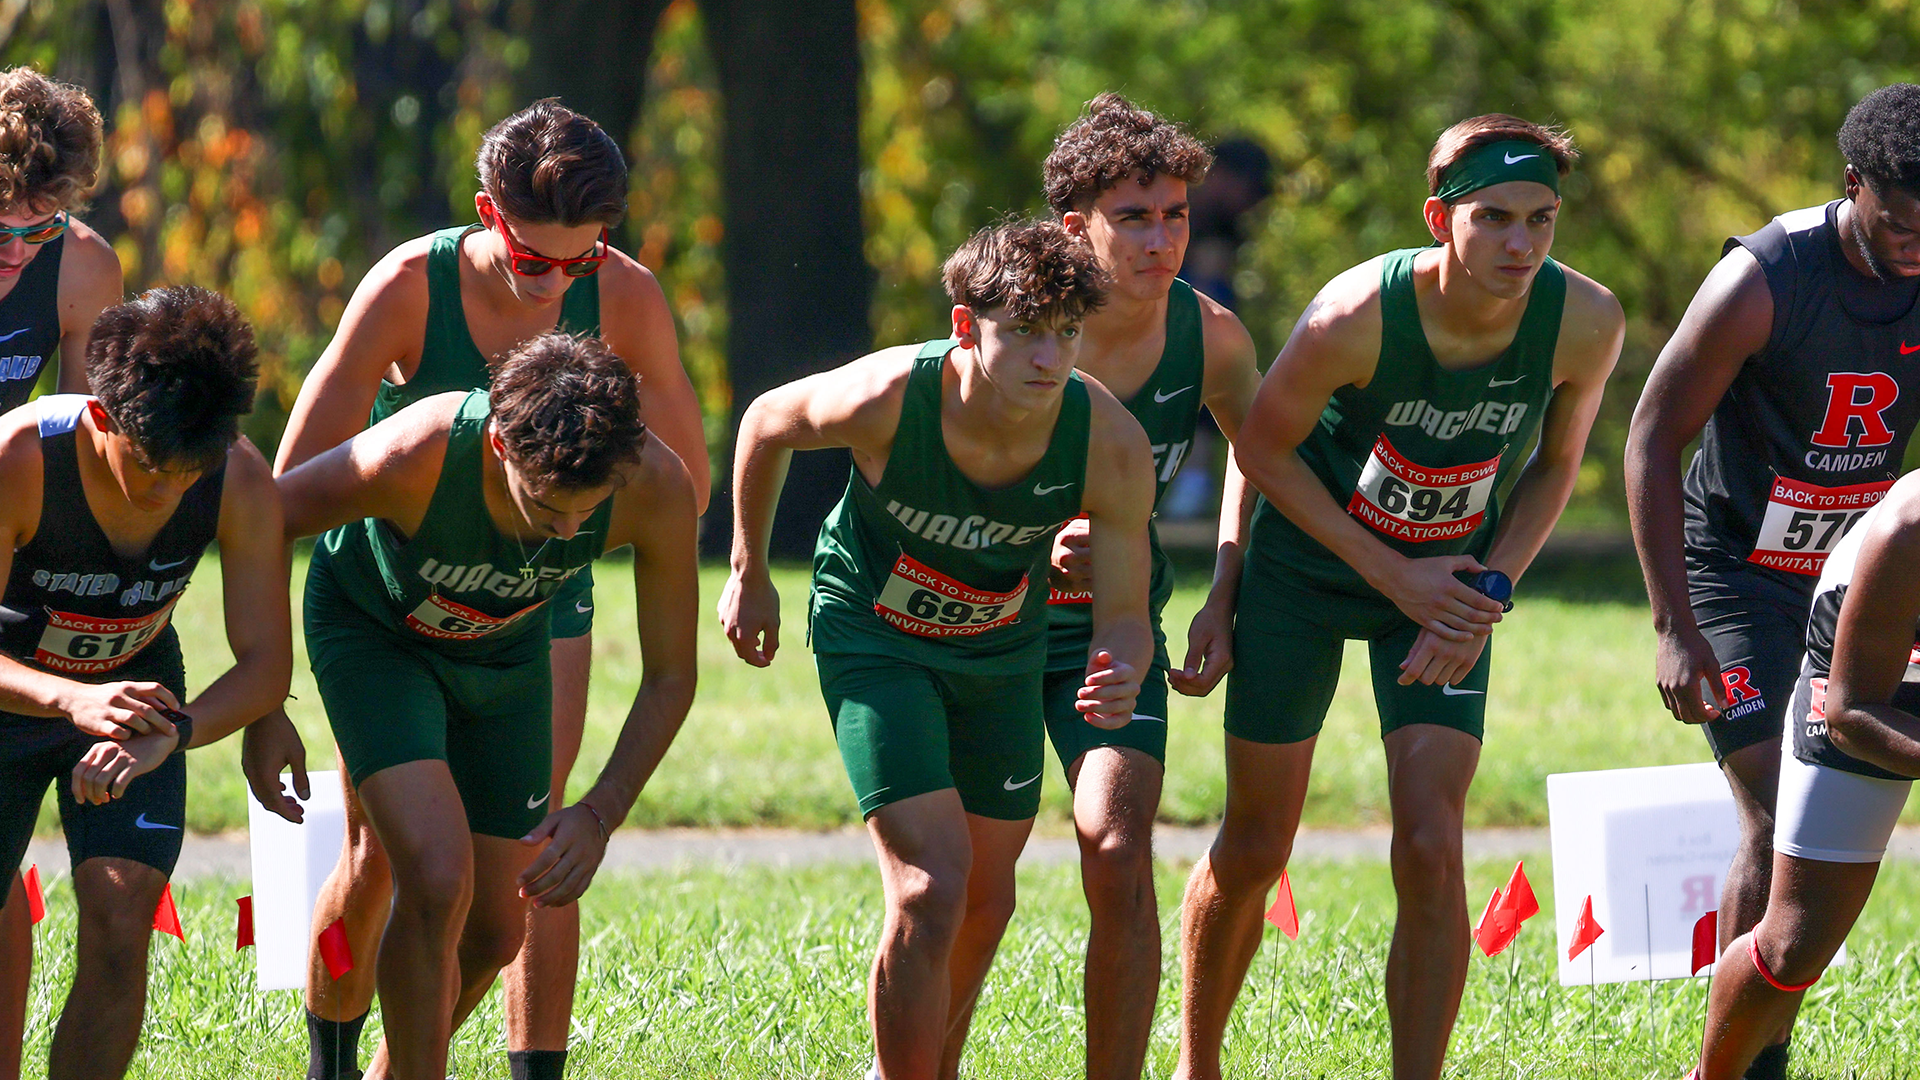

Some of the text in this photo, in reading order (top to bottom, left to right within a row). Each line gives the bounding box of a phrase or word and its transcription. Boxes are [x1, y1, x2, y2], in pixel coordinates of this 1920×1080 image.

[1810, 371, 1900, 448] R
[1376, 441, 1496, 484] BACK TO THE BOWL
[1805, 449, 1887, 472] CAMDEN
[1378, 475, 1472, 522] 694
[1774, 485, 1815, 505] BACK
[1819, 495, 1835, 506] TO
[1838, 493, 1861, 505] THE
[1359, 502, 1472, 538] INVITATIONAL
[897, 562, 937, 587] BACK
[941, 581, 959, 595] TO
[963, 591, 991, 603] THE
[438, 615, 508, 634] 69
[885, 611, 1005, 636] INVITATIONAL
[906, 588, 1005, 625] 693
[52, 618, 95, 632] BACK
[99, 623, 118, 632] TO
[1720, 665, 1761, 708] R
[1725, 698, 1766, 721] CAMDEN
